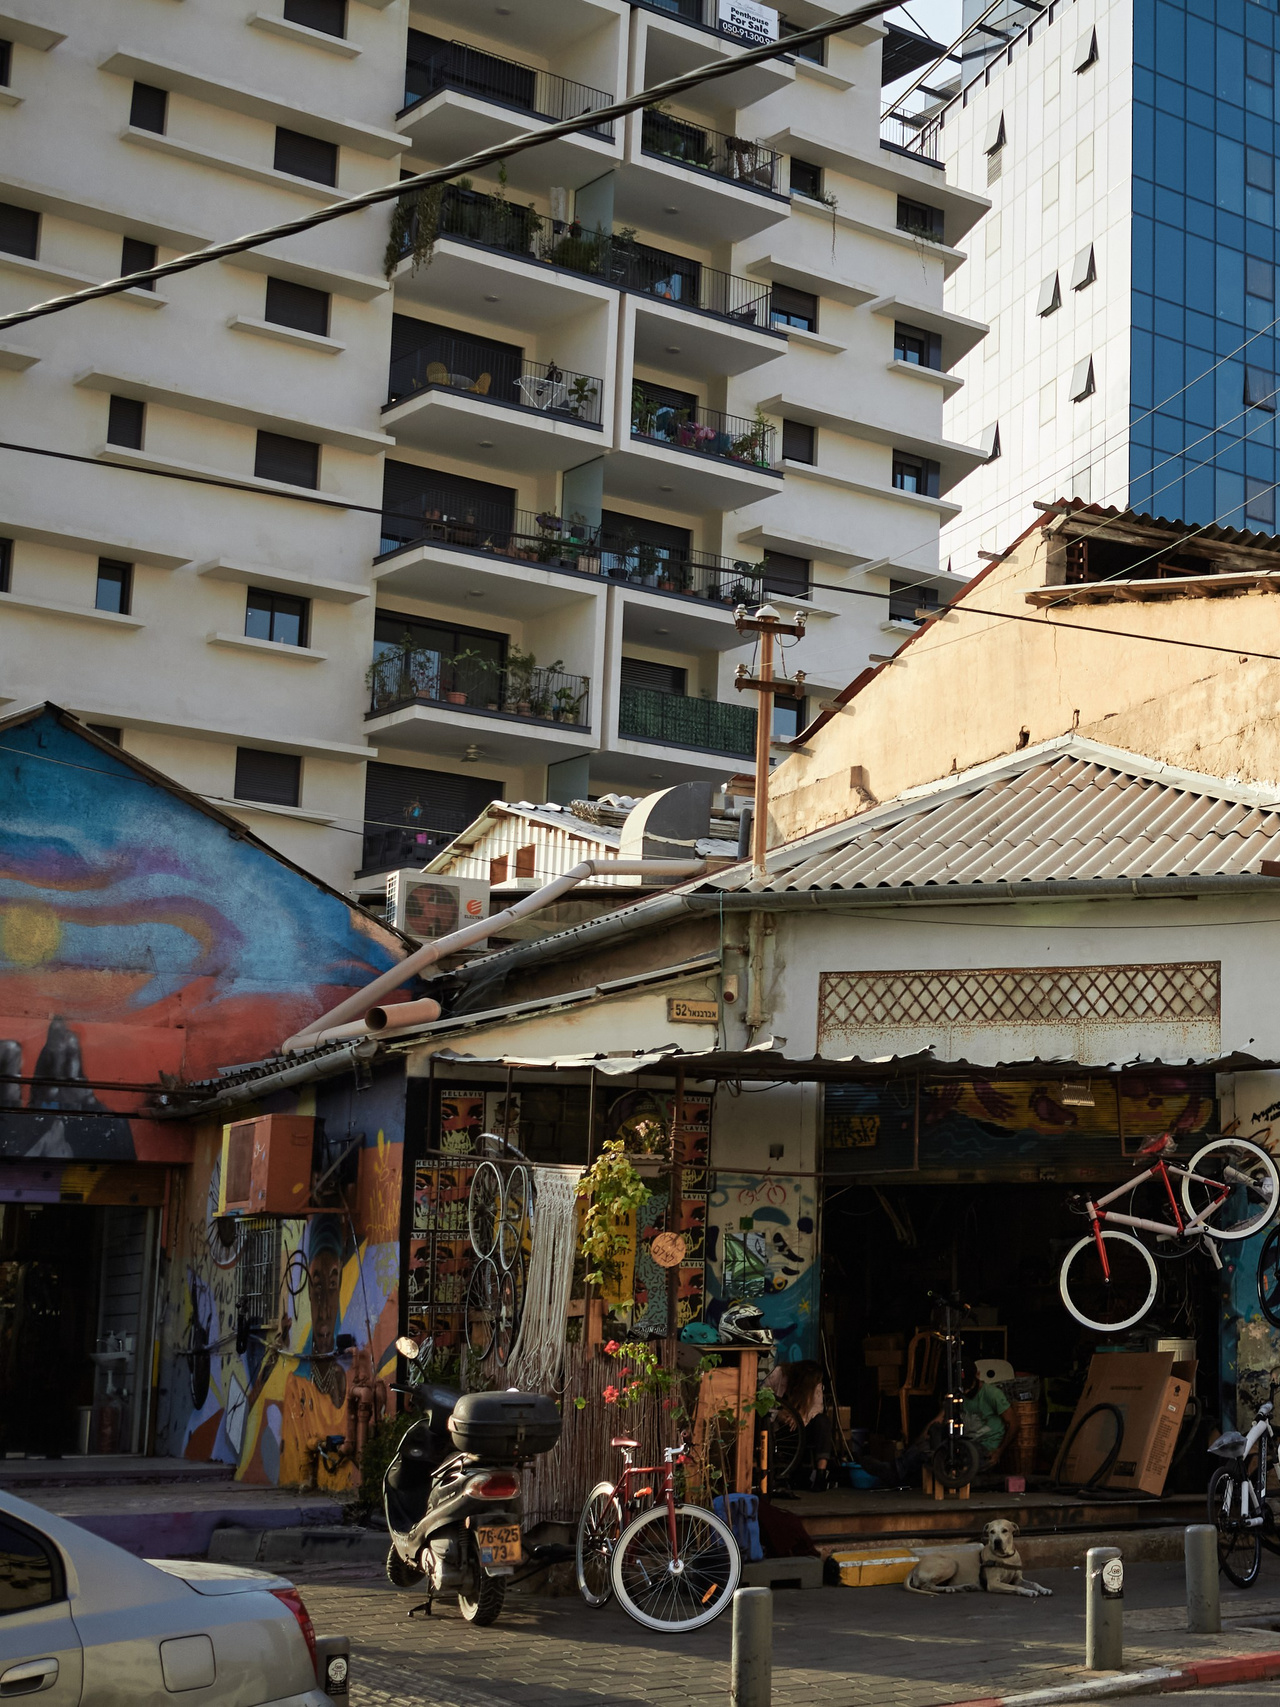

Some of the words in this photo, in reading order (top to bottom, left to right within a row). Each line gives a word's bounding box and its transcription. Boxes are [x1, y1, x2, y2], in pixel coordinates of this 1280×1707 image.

[730, 6, 769, 27] Penthouse
[730, 13, 747, 27] For
[747, 20, 769, 35] Sale
[675, 1003, 687, 1017] 52
[687, 1007, 717, 1018] אברבנאל
[493, 1545, 508, 1560] 73
